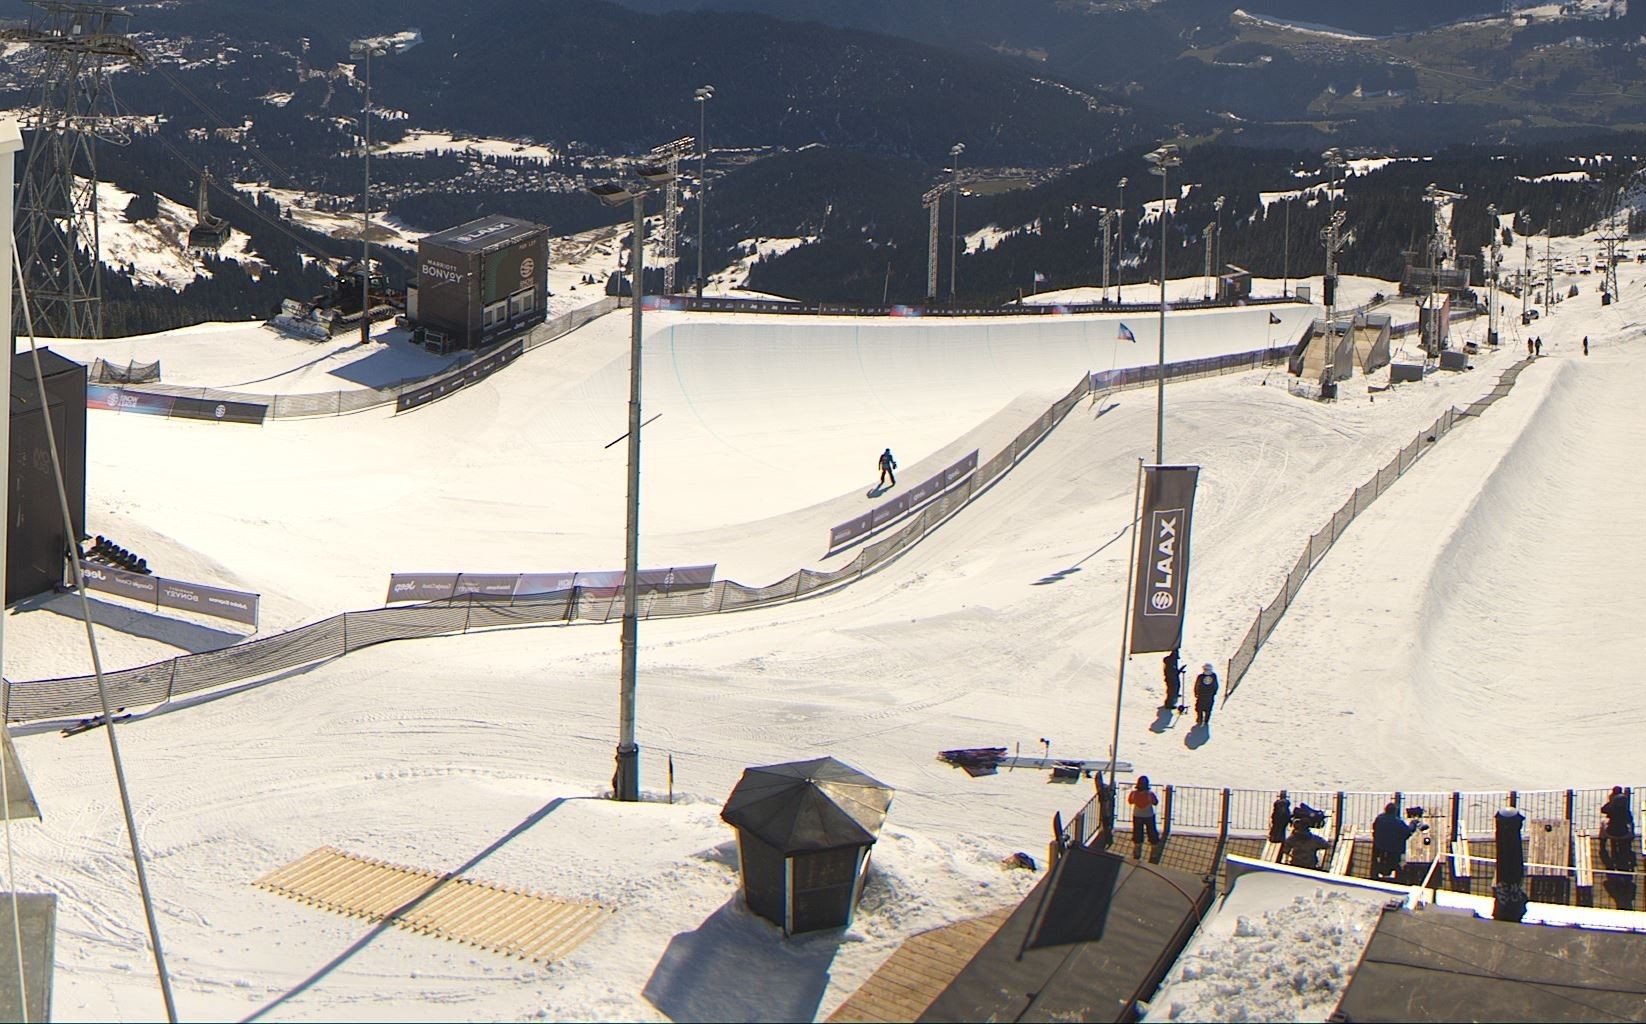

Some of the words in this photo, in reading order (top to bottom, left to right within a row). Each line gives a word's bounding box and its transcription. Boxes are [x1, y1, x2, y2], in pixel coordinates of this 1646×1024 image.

[422, 264, 462, 283] BONVOY
[427, 259, 457, 272] MARRIOTT
[1155, 517, 1176, 588] LAAX
